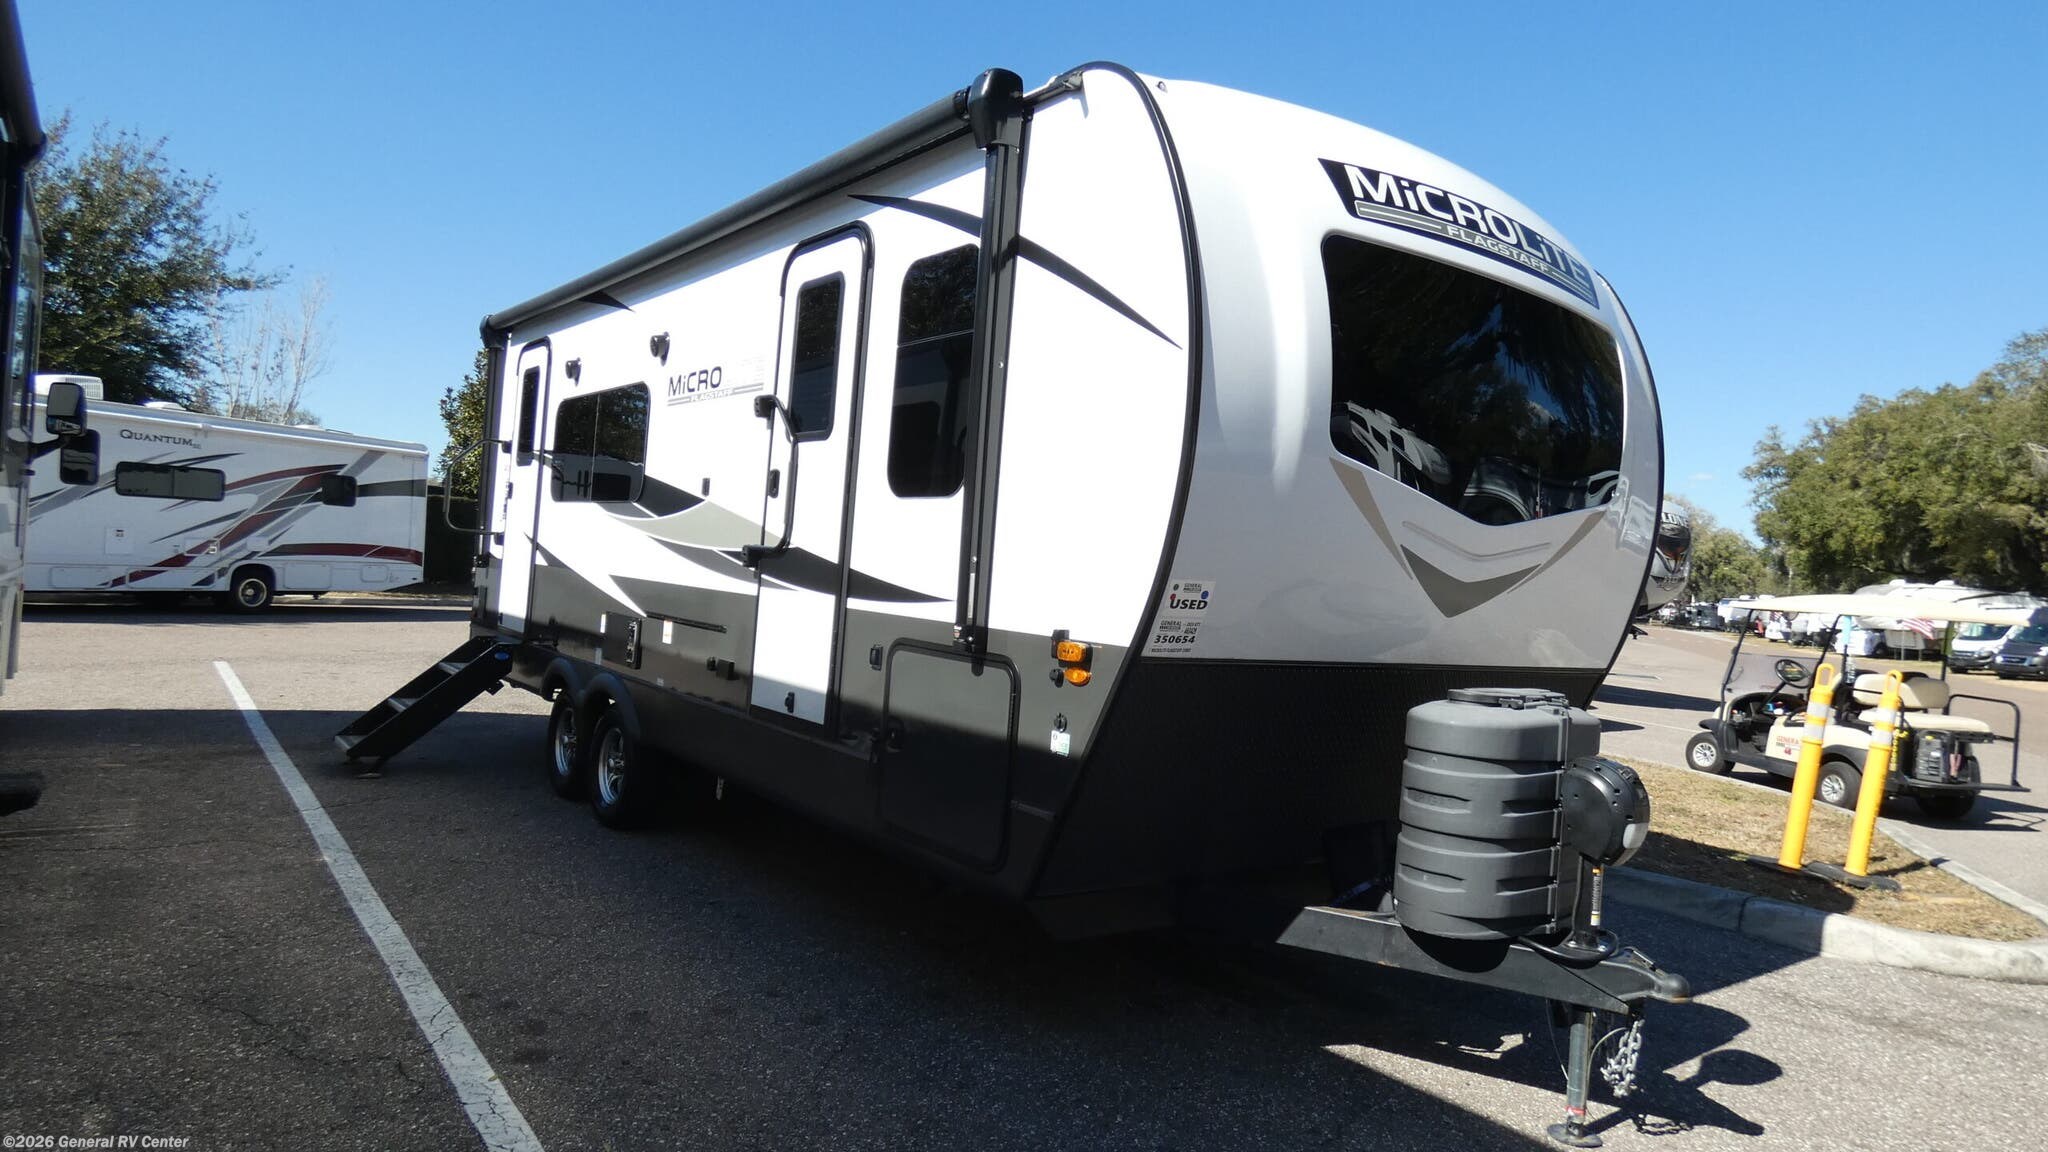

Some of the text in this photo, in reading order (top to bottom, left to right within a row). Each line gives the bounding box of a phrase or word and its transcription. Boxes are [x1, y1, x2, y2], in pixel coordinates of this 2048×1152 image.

[1446, 226, 1549, 274] FLAGSTAFF
[1170, 599, 1208, 610] USED
[1154, 635, 1196, 644] 350654
[1776, 736, 1800, 744] GENERA
